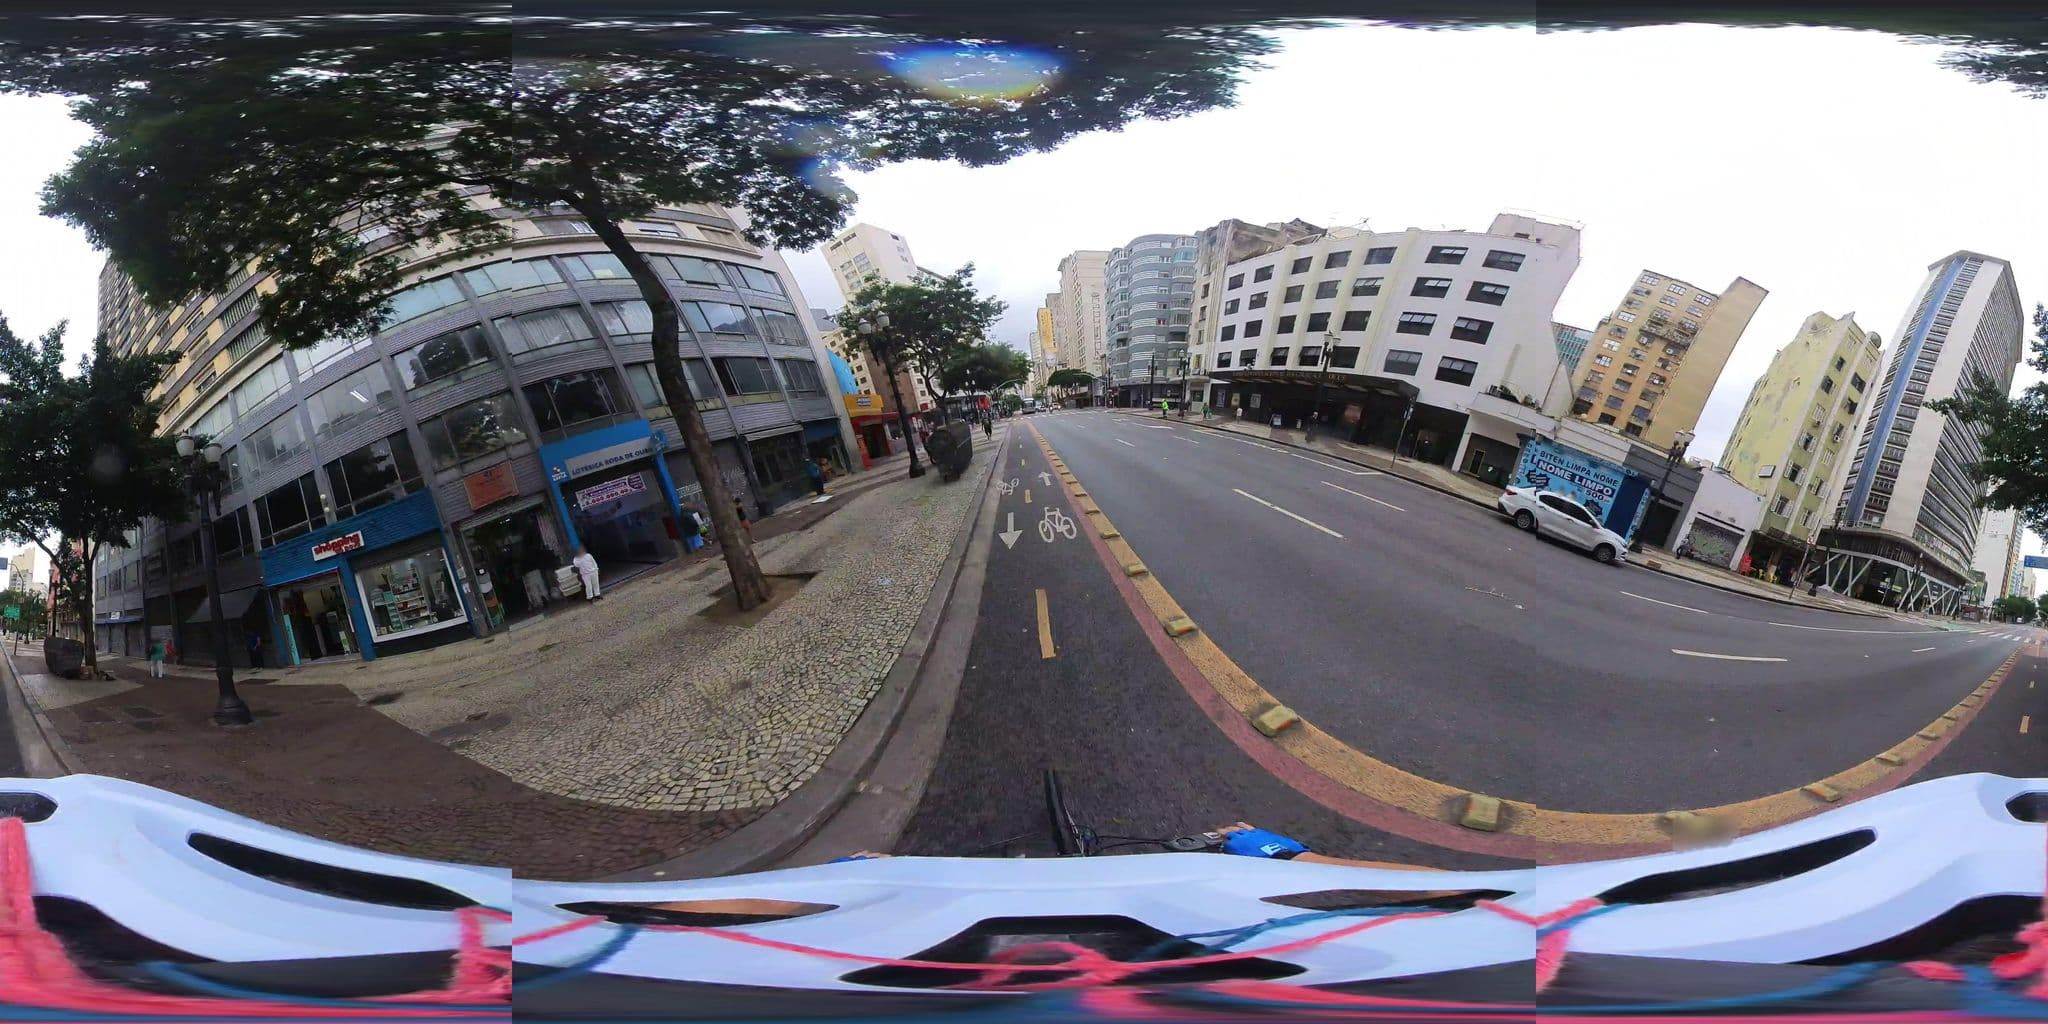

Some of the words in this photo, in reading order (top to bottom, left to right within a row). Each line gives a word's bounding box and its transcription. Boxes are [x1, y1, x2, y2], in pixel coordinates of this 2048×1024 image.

[604, 455, 624, 467] RODA
[625, 452, 633, 461] DE
[1538, 460, 1573, 480] NOME
[1574, 475, 1612, 496] LIMPO
[1565, 461, 1591, 477] LIMPA
[1594, 471, 1619, 487] NOME
[313, 532, 361, 556] shopping
